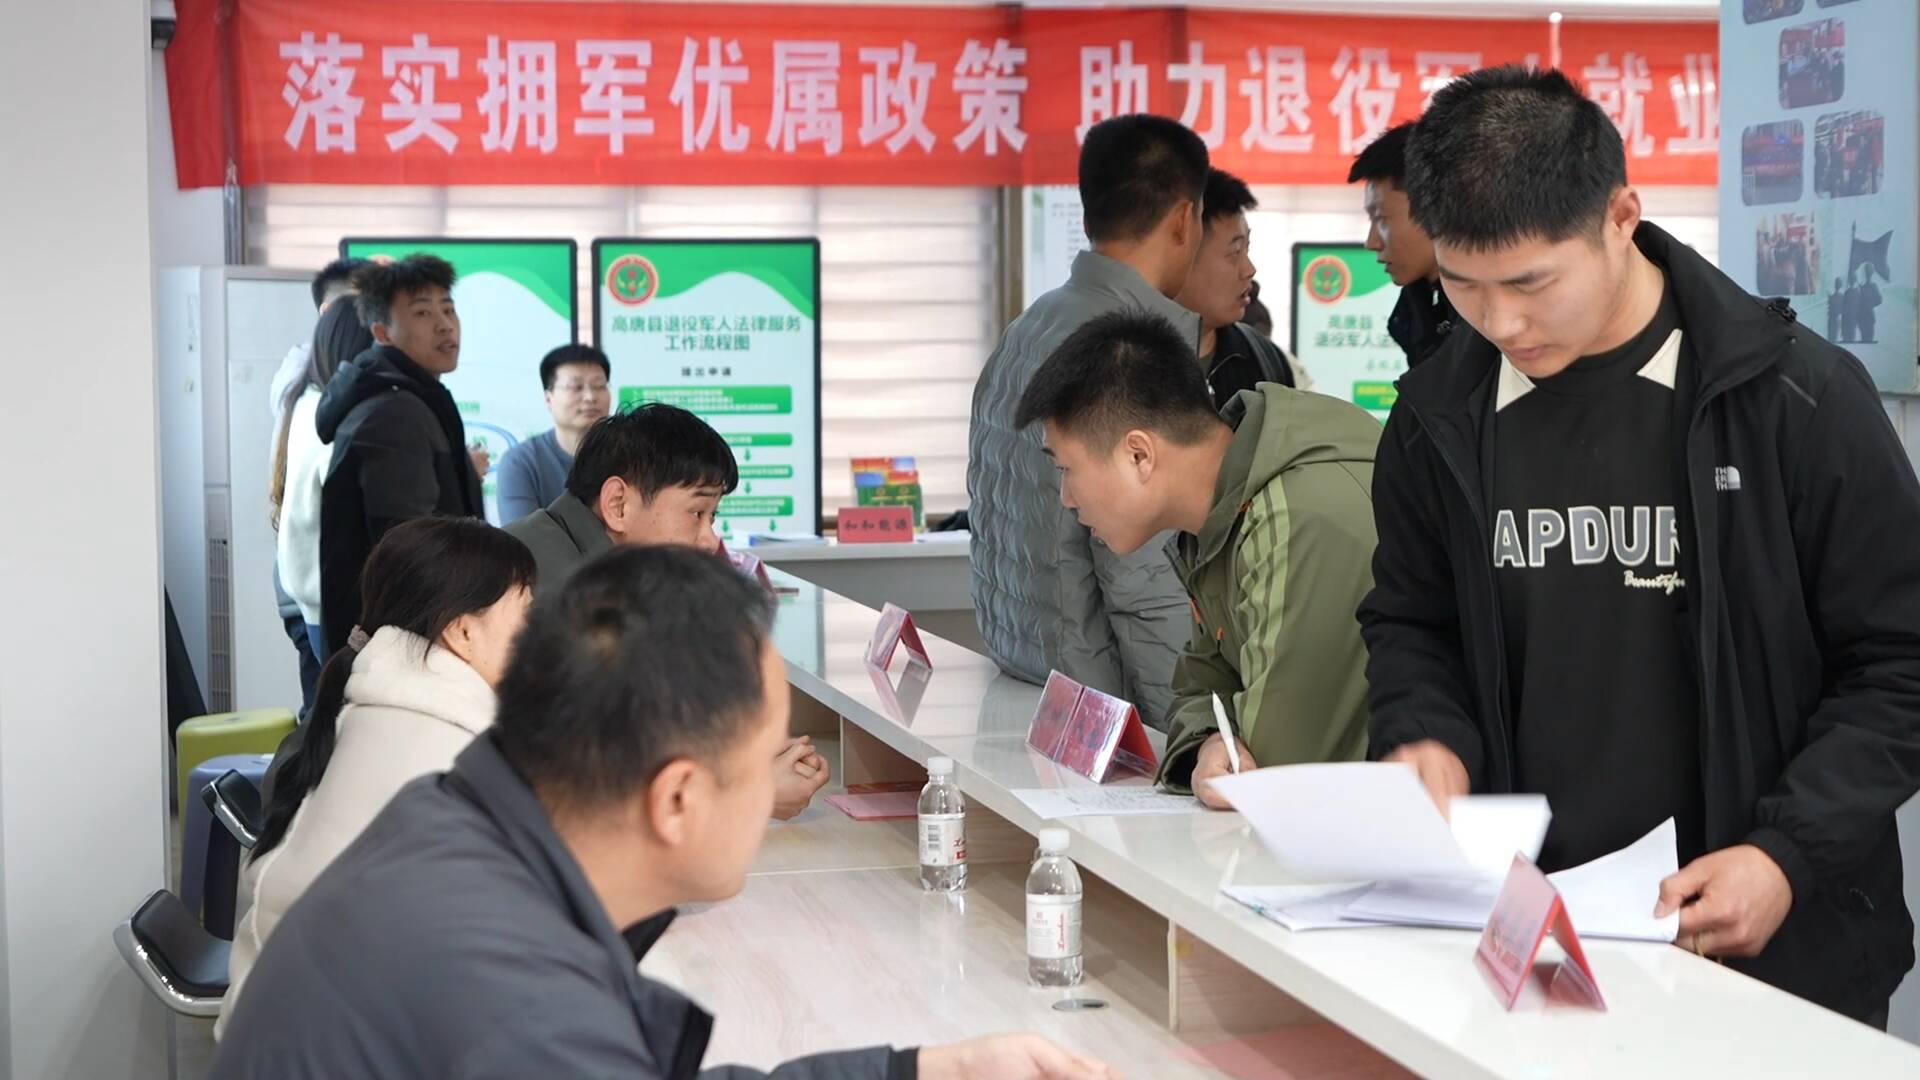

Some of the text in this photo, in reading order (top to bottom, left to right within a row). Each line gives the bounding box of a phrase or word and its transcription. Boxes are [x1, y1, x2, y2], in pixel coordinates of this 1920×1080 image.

[279, 31, 1718, 156] 落实拥军优属政策 助力退役就业
[665, 334, 750, 350] 工作流程图
